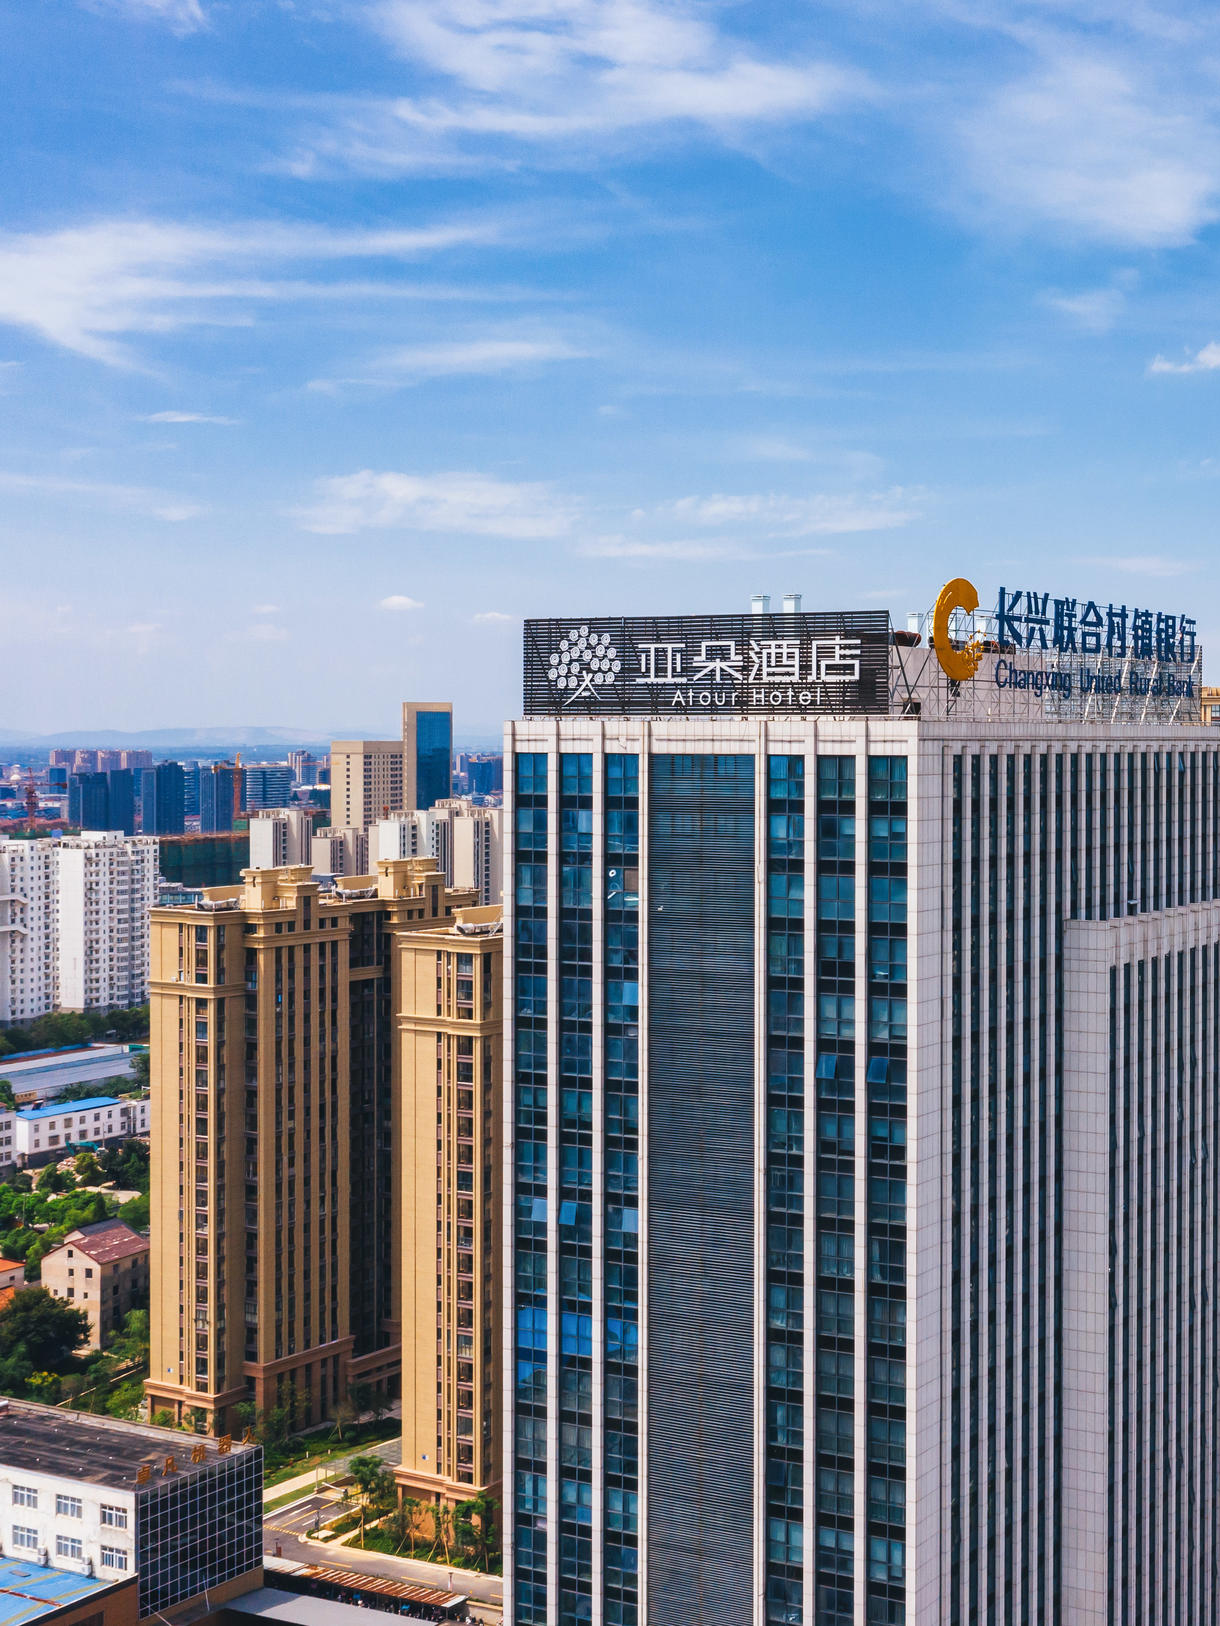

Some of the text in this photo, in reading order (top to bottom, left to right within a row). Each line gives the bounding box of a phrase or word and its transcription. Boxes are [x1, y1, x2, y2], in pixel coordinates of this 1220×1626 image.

[995, 586, 1197, 663] 长兴联合村镇银行
[636, 635, 862, 683] 亚朵酒店
[995, 659, 1194, 698] Changxing United Rural Bank
[672, 687, 821, 706] Atour Hotel
